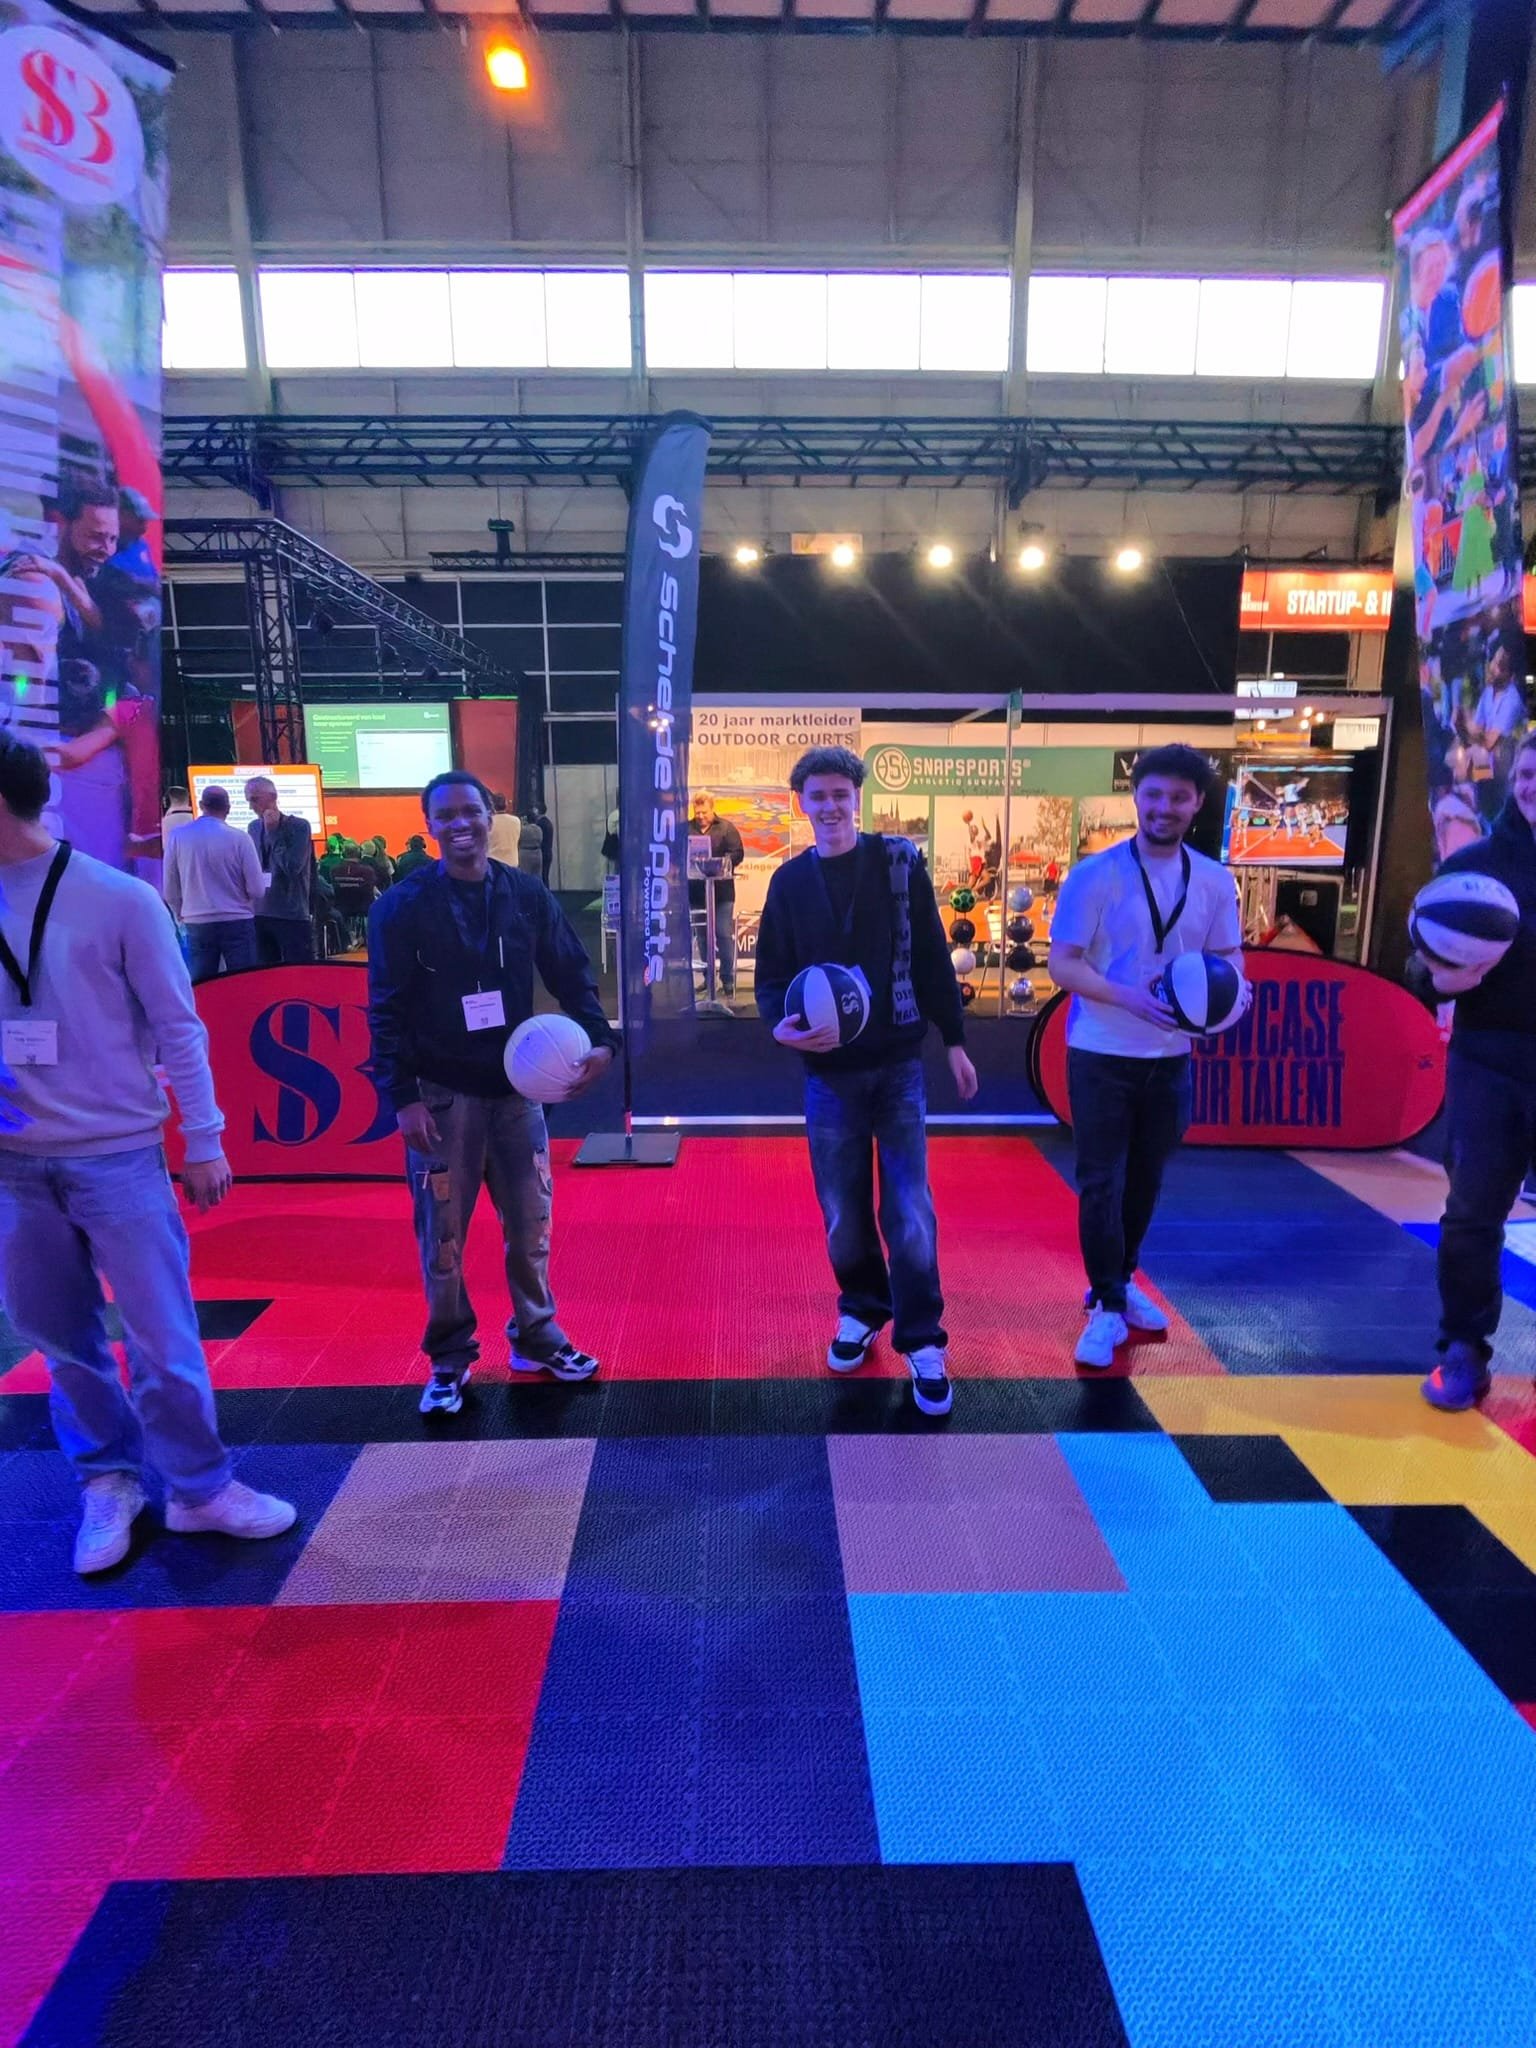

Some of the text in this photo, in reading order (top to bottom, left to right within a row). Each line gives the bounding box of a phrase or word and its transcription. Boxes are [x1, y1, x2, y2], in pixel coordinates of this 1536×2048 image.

[1287, 589, 1362, 615] STARTUP-
[699, 713, 856, 729] 20 jaar marktleider
[697, 732, 855, 746] OUTDOOR COURTS
[648, 808, 676, 982] Sports
[1240, 1059, 1345, 1127] TALENT
